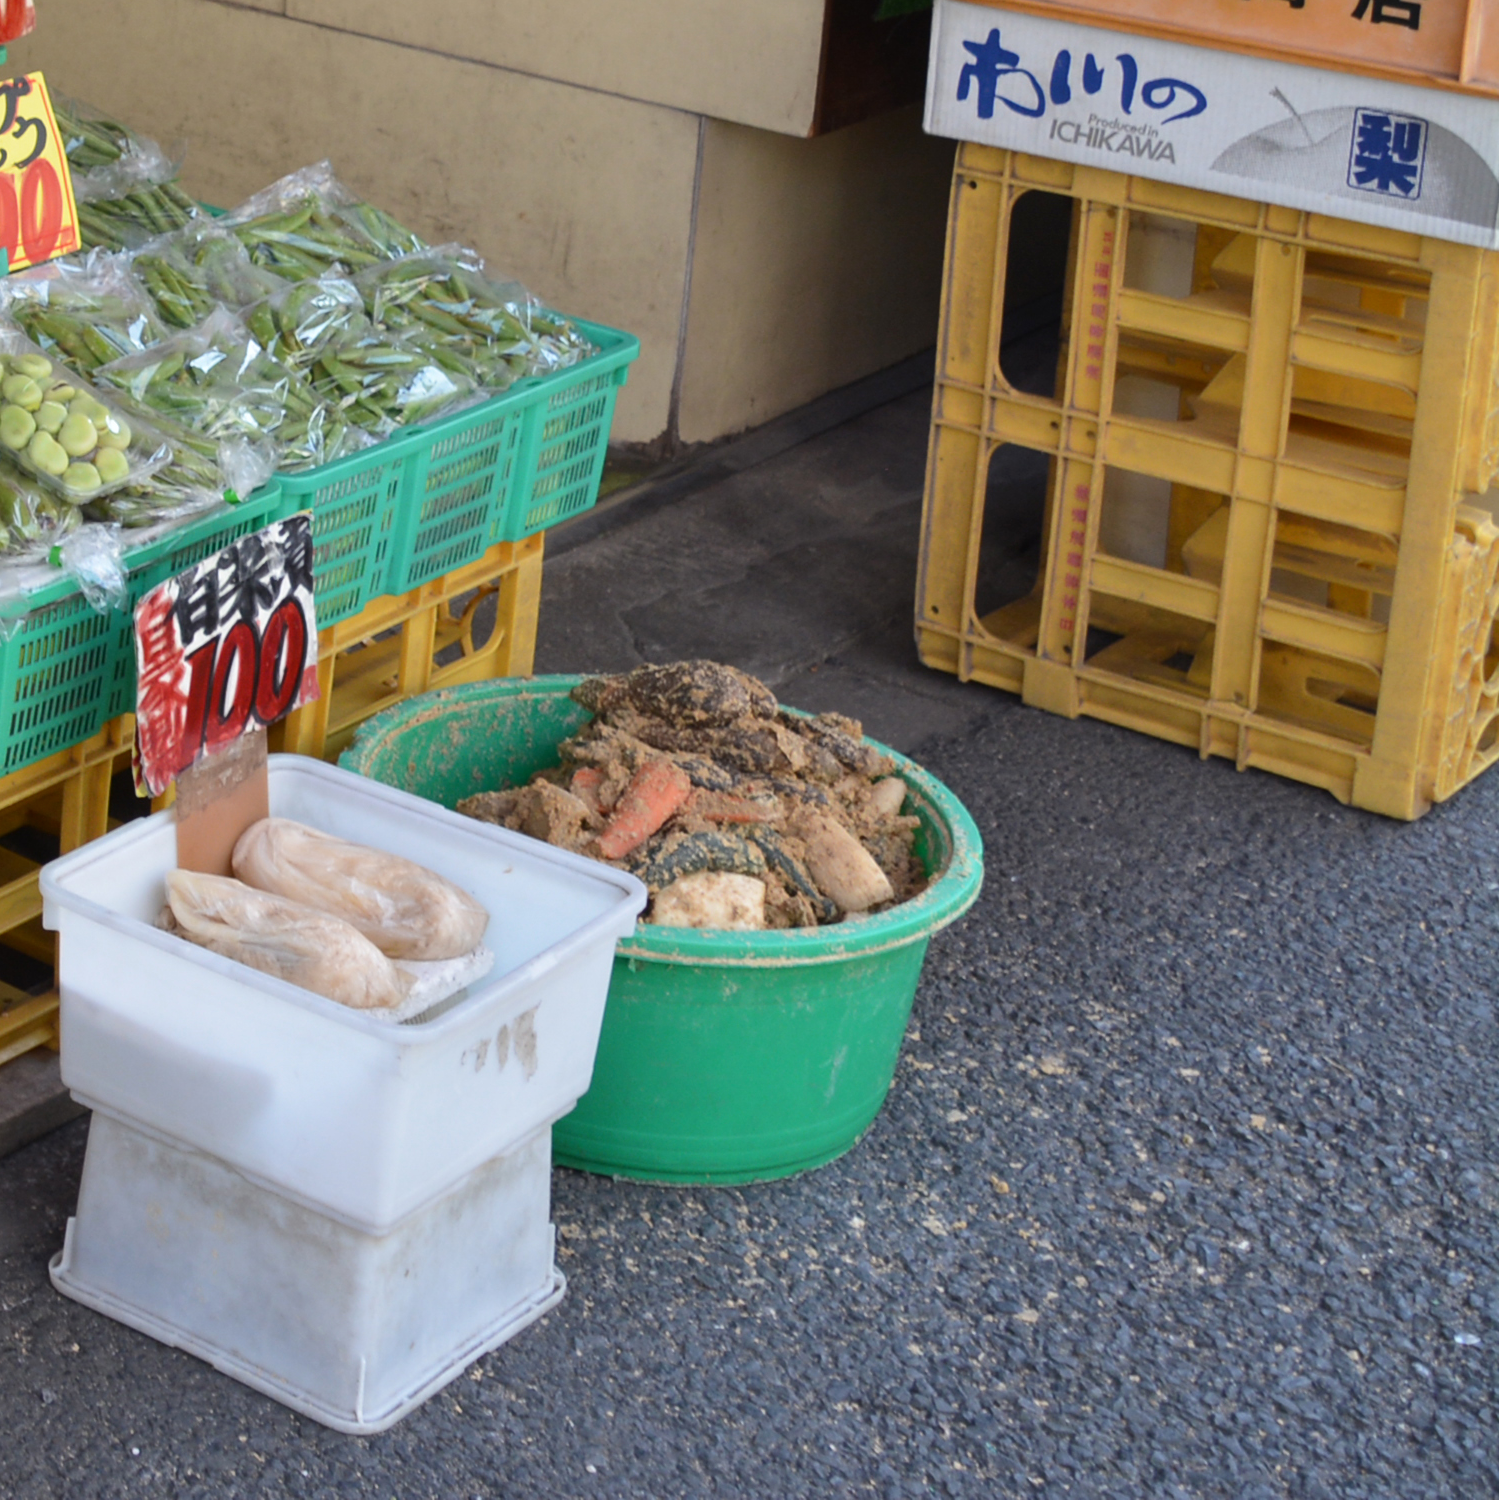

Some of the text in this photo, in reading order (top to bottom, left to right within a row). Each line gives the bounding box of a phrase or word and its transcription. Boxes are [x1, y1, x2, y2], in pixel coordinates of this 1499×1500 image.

[955, 27, 1208, 126] 市川の
[1047, 117, 1178, 166] ICHIKAWA
[1087, 112, 1160, 138] Produced in
[1353, 111, 1422, 199] 梨
[180, 596, 309, 770] 100
